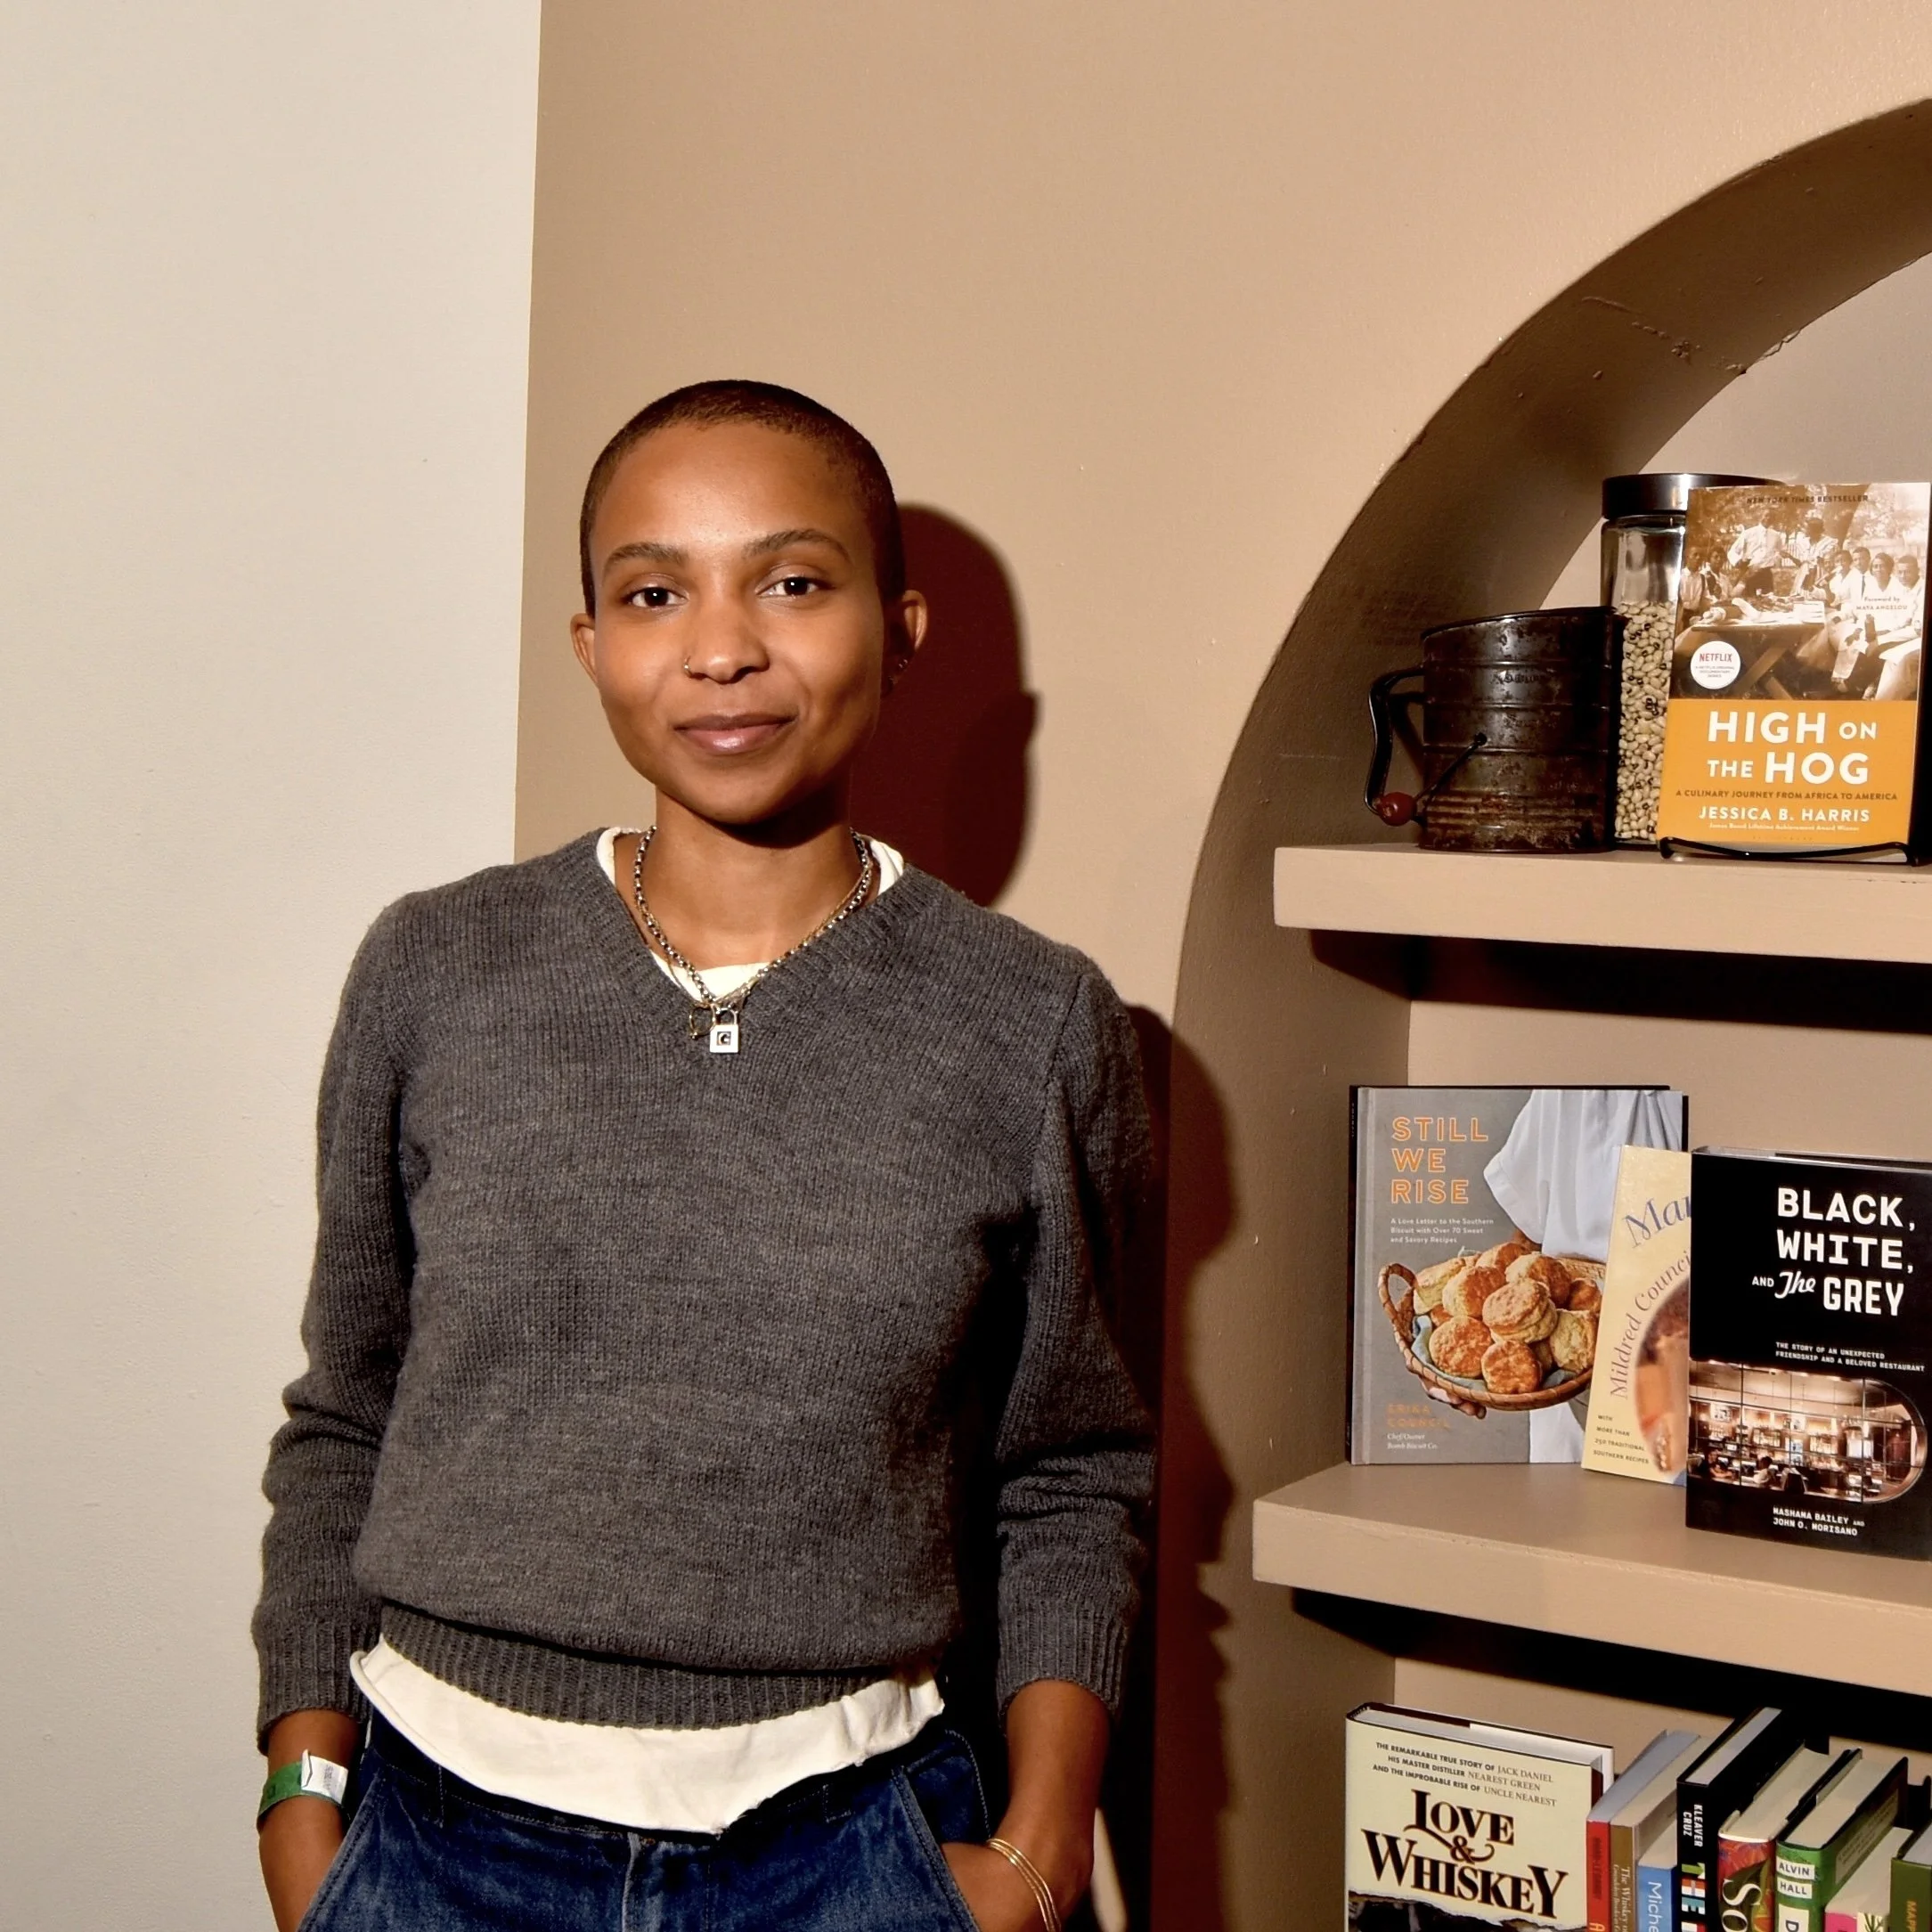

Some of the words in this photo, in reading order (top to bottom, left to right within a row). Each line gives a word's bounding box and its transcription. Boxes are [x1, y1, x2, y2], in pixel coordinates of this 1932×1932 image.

[1817, 494, 1868, 502] BESTSELLER
[1700, 653, 1732, 663] NETFLIX
[1708, 711, 1826, 744] HIGH
[1838, 721, 1877, 740] ON
[1708, 759, 1753, 779] THE
[1765, 752, 1869, 784] HOG
[1684, 789, 1729, 797] CULINARY
[1805, 792, 1838, 800] AFRICA
[1855, 793, 1897, 801] AMERICA
[1699, 806, 1772, 820] JESSICA
[1779, 808, 1794, 821] B.
[1802, 808, 1870, 822] HARRIS
[1391, 1116, 1489, 1143] STILL
[1391, 1148, 1447, 1174] WE
[1390, 1179, 1470, 1204] RISE
[1777, 1187, 1915, 1232] BLACK,
[1405, 1236, 1428, 1244] Savory
[1431, 1236, 1457, 1244] Recipes
[1776, 1229, 1914, 1274] WHITE,
[1751, 1276, 1774, 1288] AND
[1774, 1271, 1815, 1299] The
[1822, 1277, 1904, 1317] GREY
[1610, 1312, 1642, 1400] Mildred
[1775, 1350, 1818, 1361] FRIENDSHIP
[1845, 1358, 1877, 1368] BELOVED
[1879, 1362, 1925, 1372] RESTAURANT
[1776, 1341, 1789, 1349] THE
[1791, 1343, 1814, 1353] STORY
[1840, 1349, 1885, 1359] UNEXPECTED
[1593, 1449, 1624, 1459] SOUTHERN
[1626, 1455, 1649, 1463] RECIPES
[1608, 1440, 1644, 1451] TRADITIONAL
[1773, 1507, 1813, 1520] MASHAMA
[1814, 1512, 1849, 1524] BAILEY
[1773, 1517, 1796, 1528] JOHN
[1797, 1520, 1807, 1529] O.
[1812, 1522, 1858, 1536] MORISANO
[1376, 1742, 1389, 1750] THE
[1390, 1745, 1438, 1760] REMARKABLE
[1439, 1755, 1457, 1764] TRUE
[1459, 1759, 1482, 1769] STORY
[1496, 1765, 1519, 1776] JACK
[1520, 1770, 1553, 1782] DANIEL
[1388, 1756, 1399, 1764] HIS
[1402, 1758, 1430, 1770] MASTER
[1432, 1765, 1465, 1777] DISTILLER
[1468, 1771, 1508, 1785] NEAREST
[1510, 1779, 1541, 1791] GREEN
[1373, 1764, 1390, 1773] AND
[1390, 1767, 1404, 1776] THE
[1406, 1770, 1451, 1786] IMPROBABLE
[1453, 1781, 1468, 1789] RISE
[1471, 1784, 1480, 1792] OF
[1484, 1786, 1514, 1798] UNCLE
[1516, 1792, 1557, 1806] NEAREST
[1403, 1789, 1514, 1846] LOVE
[1683, 1812, 1692, 1837] CRUZ
[1694, 1804, 1703, 1847] KLEAVER
[1450, 1835, 1495, 1863] &
[1361, 1829, 1569, 1919] WHISKEY
[1621, 1867, 1631, 1885] The
[1779, 1862, 1810, 1876] ALVIN
[1682, 1862, 1705, 1915] THE
[1780, 1881, 1807, 1895] HALL
